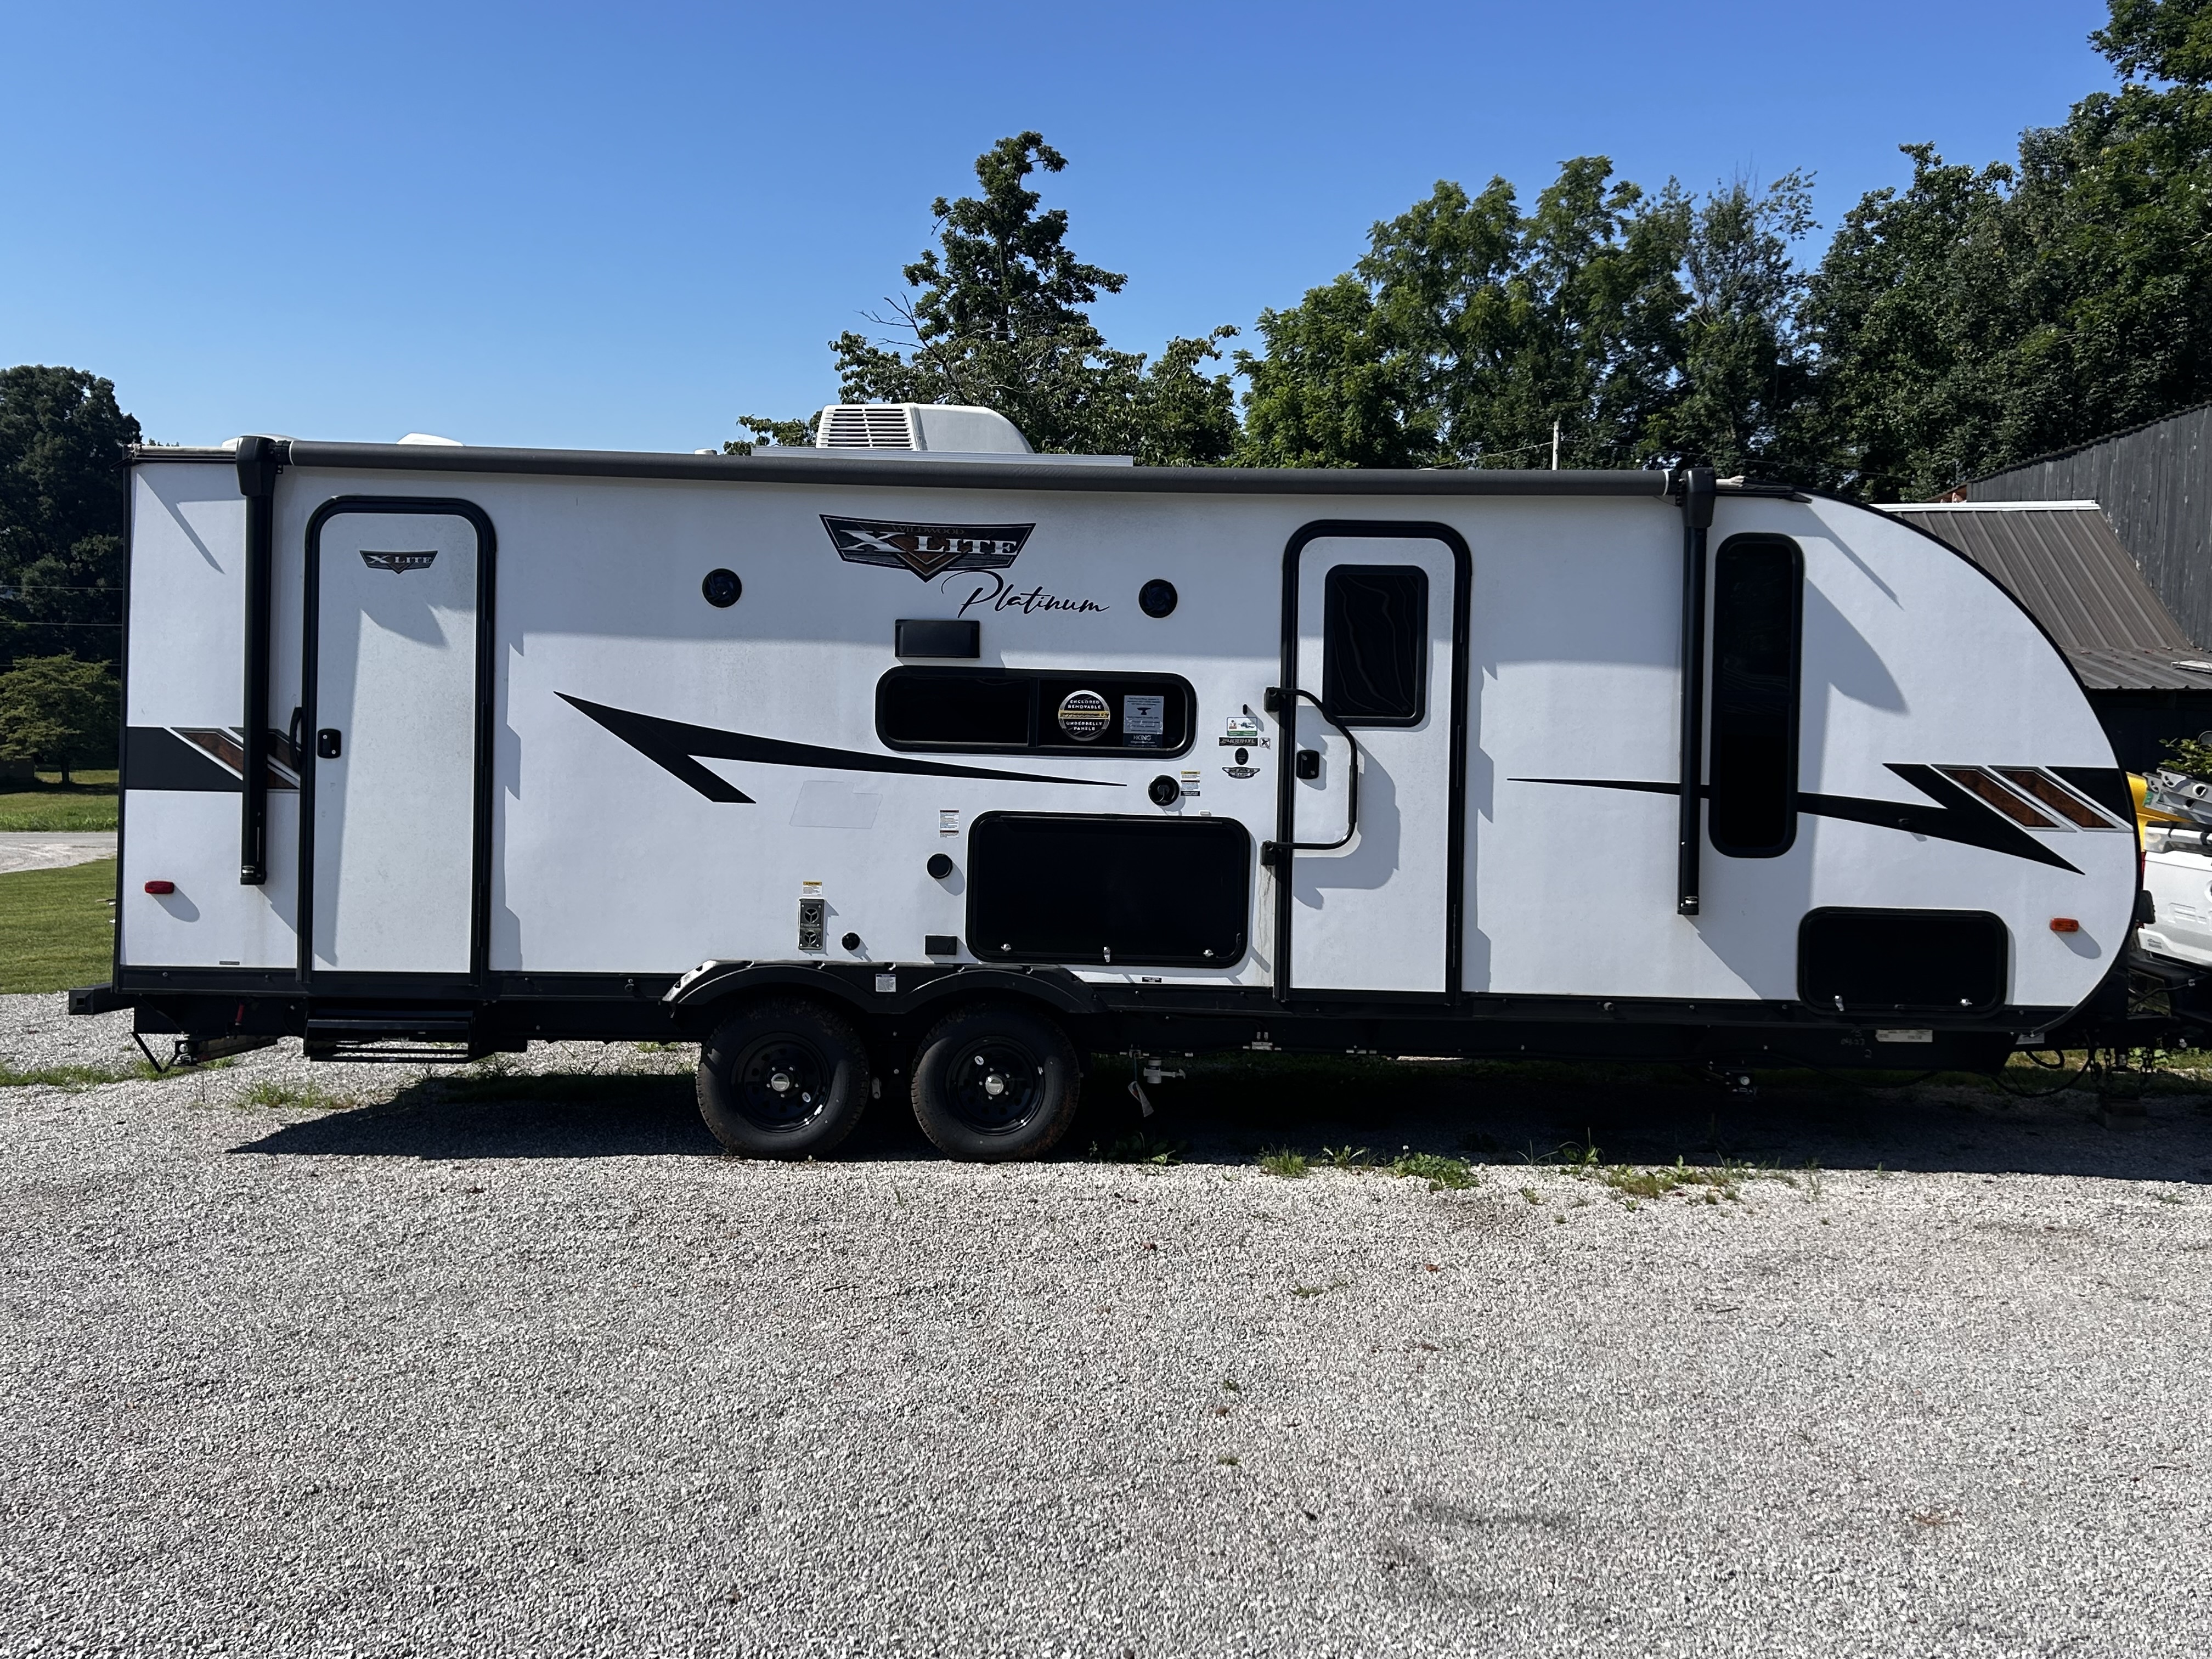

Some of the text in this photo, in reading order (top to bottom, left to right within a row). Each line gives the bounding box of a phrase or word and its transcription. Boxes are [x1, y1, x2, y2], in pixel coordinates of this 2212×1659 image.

[891, 526, 965, 534] WILDWOOD
[838, 529, 1018, 555] X LITE
[366, 555, 391, 564] X
[941, 569, 1110, 618] Platinum
